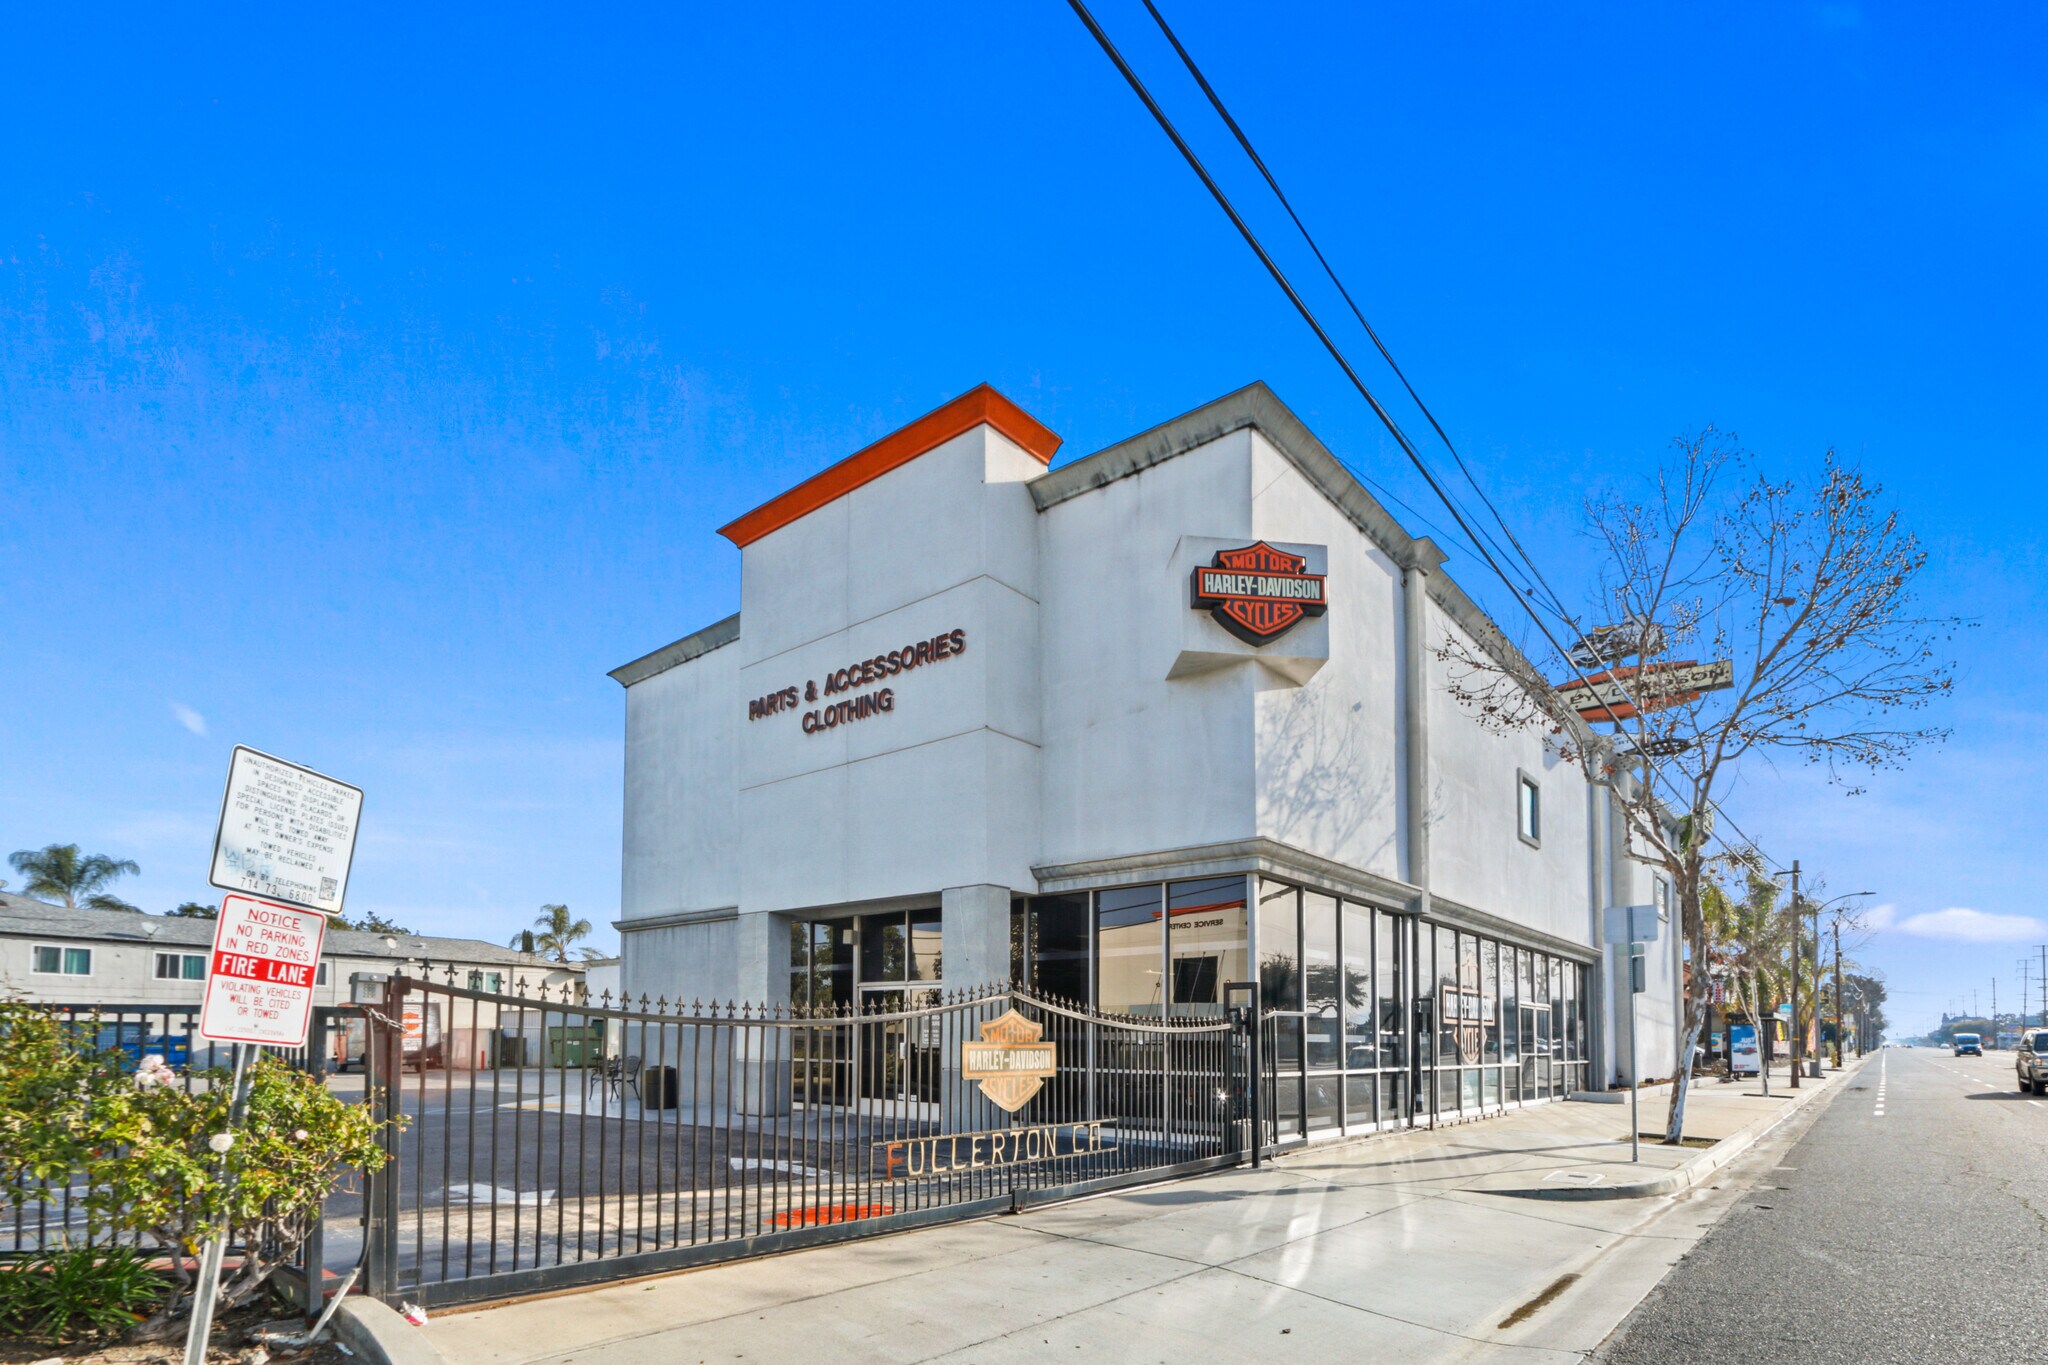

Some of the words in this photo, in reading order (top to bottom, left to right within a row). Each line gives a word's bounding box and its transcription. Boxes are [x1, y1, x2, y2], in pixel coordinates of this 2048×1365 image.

[1231, 549, 1293, 572] MOTOR
[1204, 573, 1320, 600] HARLEY-DAVIDSON
[1233, 602, 1294, 629] CYCLES
[749, 685, 800, 721] PARTS
[804, 679, 818, 702] &
[824, 628, 967, 697] ACCESSORIES
[802, 687, 895, 734] CLOTHING
[243, 756, 294, 779] UNAUTHORIZED
[299, 774, 328, 791] VEHICLES
[332, 787, 355, 800] PARKED
[264, 772, 303, 791] DESIGNATED
[308, 788, 344, 805] ACCESSIBLE
[245, 784, 297, 807] DISTINGUISHING
[301, 802, 332, 819] PLACARDS
[336, 814, 345, 822] OR
[257, 779, 281, 793] SPACES
[286, 789, 298, 798] NOT
[302, 794, 338, 812] DISPLAYING
[235, 800, 249, 810] FOR
[254, 806, 284, 822] PERSONS
[290, 818, 305, 828] WITH
[309, 823, 347, 841] DISABILITIES
[237, 791, 265, 807] SPECIAL
[270, 802, 296, 816] LICENSE
[301, 811, 324, 825] PLATES
[328, 820, 349, 833] ISSUED
[244, 822, 252, 830] AT
[257, 826, 270, 836] THE
[274, 831, 303, 845] OWNER'S
[307, 840, 334, 855] EXPENSE
[255, 816, 269, 827] WILL
[274, 821, 283, 831] BE
[289, 826, 309, 839] TOWED
[314, 834, 328, 844] AWAY
[246, 847, 259, 856] MAY
[264, 851, 273, 860] BE
[278, 855, 314, 870] RECLAIMED
[318, 865, 325, 873] AT
[260, 840, 281, 853] TOWED
[286, 849, 316, 862] VEHICLES
[241, 876, 259, 890] 714
[265, 883, 281, 897] 73
[289, 889, 313, 904] 6800
[246, 869, 256, 878] OR
[260, 873, 269, 882] BY
[275, 876, 317, 894] TELEPHONING
[247, 908, 302, 930] NOTICE
[226, 937, 239, 949] IN
[245, 940, 269, 955] RED
[275, 946, 310, 962] ZONES
[236, 924, 253, 937] NO
[260, 928, 306, 948] PARKING
[220, 954, 259, 978] FIRE
[267, 962, 309, 985] LANE
[220, 980, 262, 995] VIOLATING
[266, 986, 302, 1000] VEHICLES
[229, 994, 248, 1005] WILL
[253, 997, 264, 1007] BE
[268, 999, 290, 1010] CITED
[237, 1006, 249, 1017] OR
[253, 1008, 279, 1020] TOWED
[990, 1018, 1034, 1042] MOTOR
[969, 1050, 1051, 1071] HARLEY-DAVIDSON
[988, 1077, 1034, 1101] CYCLES
[887, 1127, 1058, 1181] FULLERTON
[1072, 1123, 1101, 1153] CA
